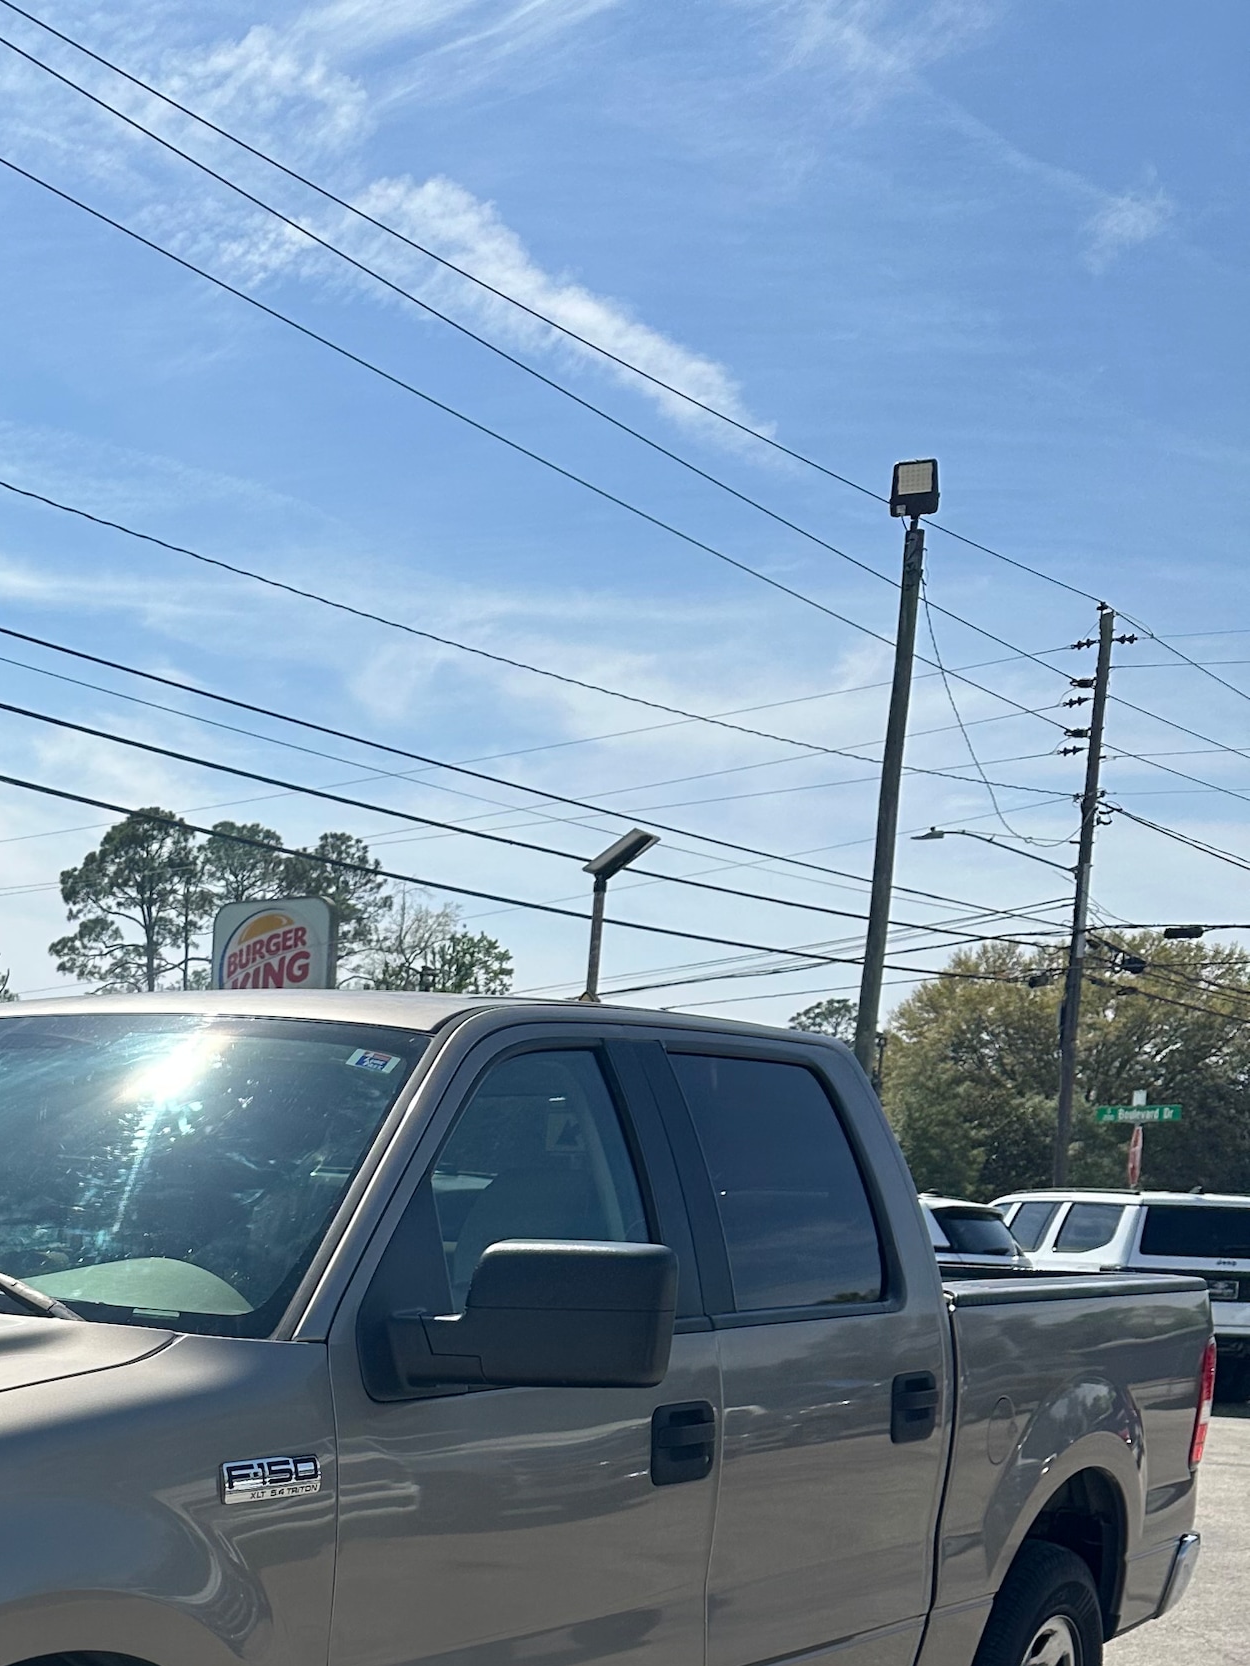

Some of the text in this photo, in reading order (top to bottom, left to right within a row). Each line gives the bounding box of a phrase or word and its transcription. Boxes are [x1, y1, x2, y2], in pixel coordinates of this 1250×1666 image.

[227, 926, 307, 979] BURGER
[1118, 1108, 1160, 1120] Boulevard
[1163, 1107, 1174, 1119] Dr
[250, 1491, 266, 1500] XLT
[286, 1484, 318, 1495] TRITON
